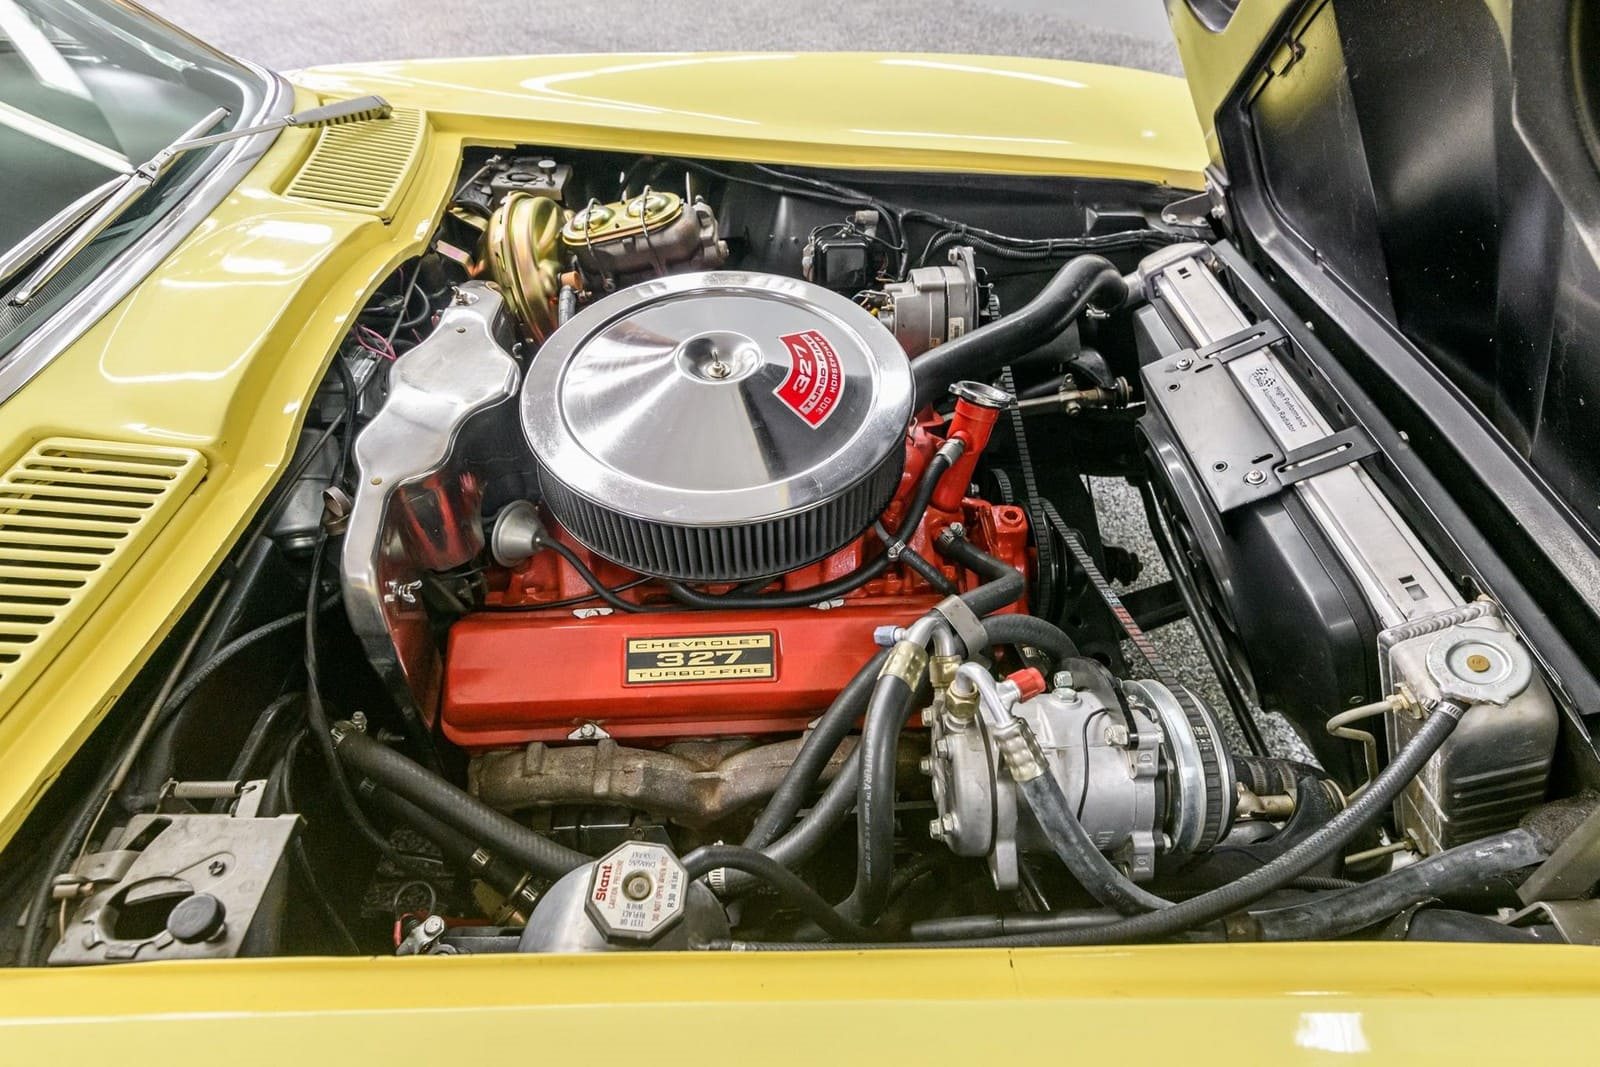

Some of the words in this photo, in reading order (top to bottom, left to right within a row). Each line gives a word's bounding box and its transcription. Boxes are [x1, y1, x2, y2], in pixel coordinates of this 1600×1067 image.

[792, 343, 812, 394] 327
[803, 335, 826, 409] TURBO-FIRE
[814, 336, 838, 393] HORSEPOWER
[816, 396, 831, 415] 300
[1274, 386, 1285, 398] High
[1284, 396, 1307, 428] Performance
[1280, 411, 1296, 432] Radiator
[636, 638, 764, 649] CHEVROLET
[636, 667, 765, 678] TURBO-FIRE
[656, 650, 743, 667] 327
[595, 864, 612, 901] Stant
